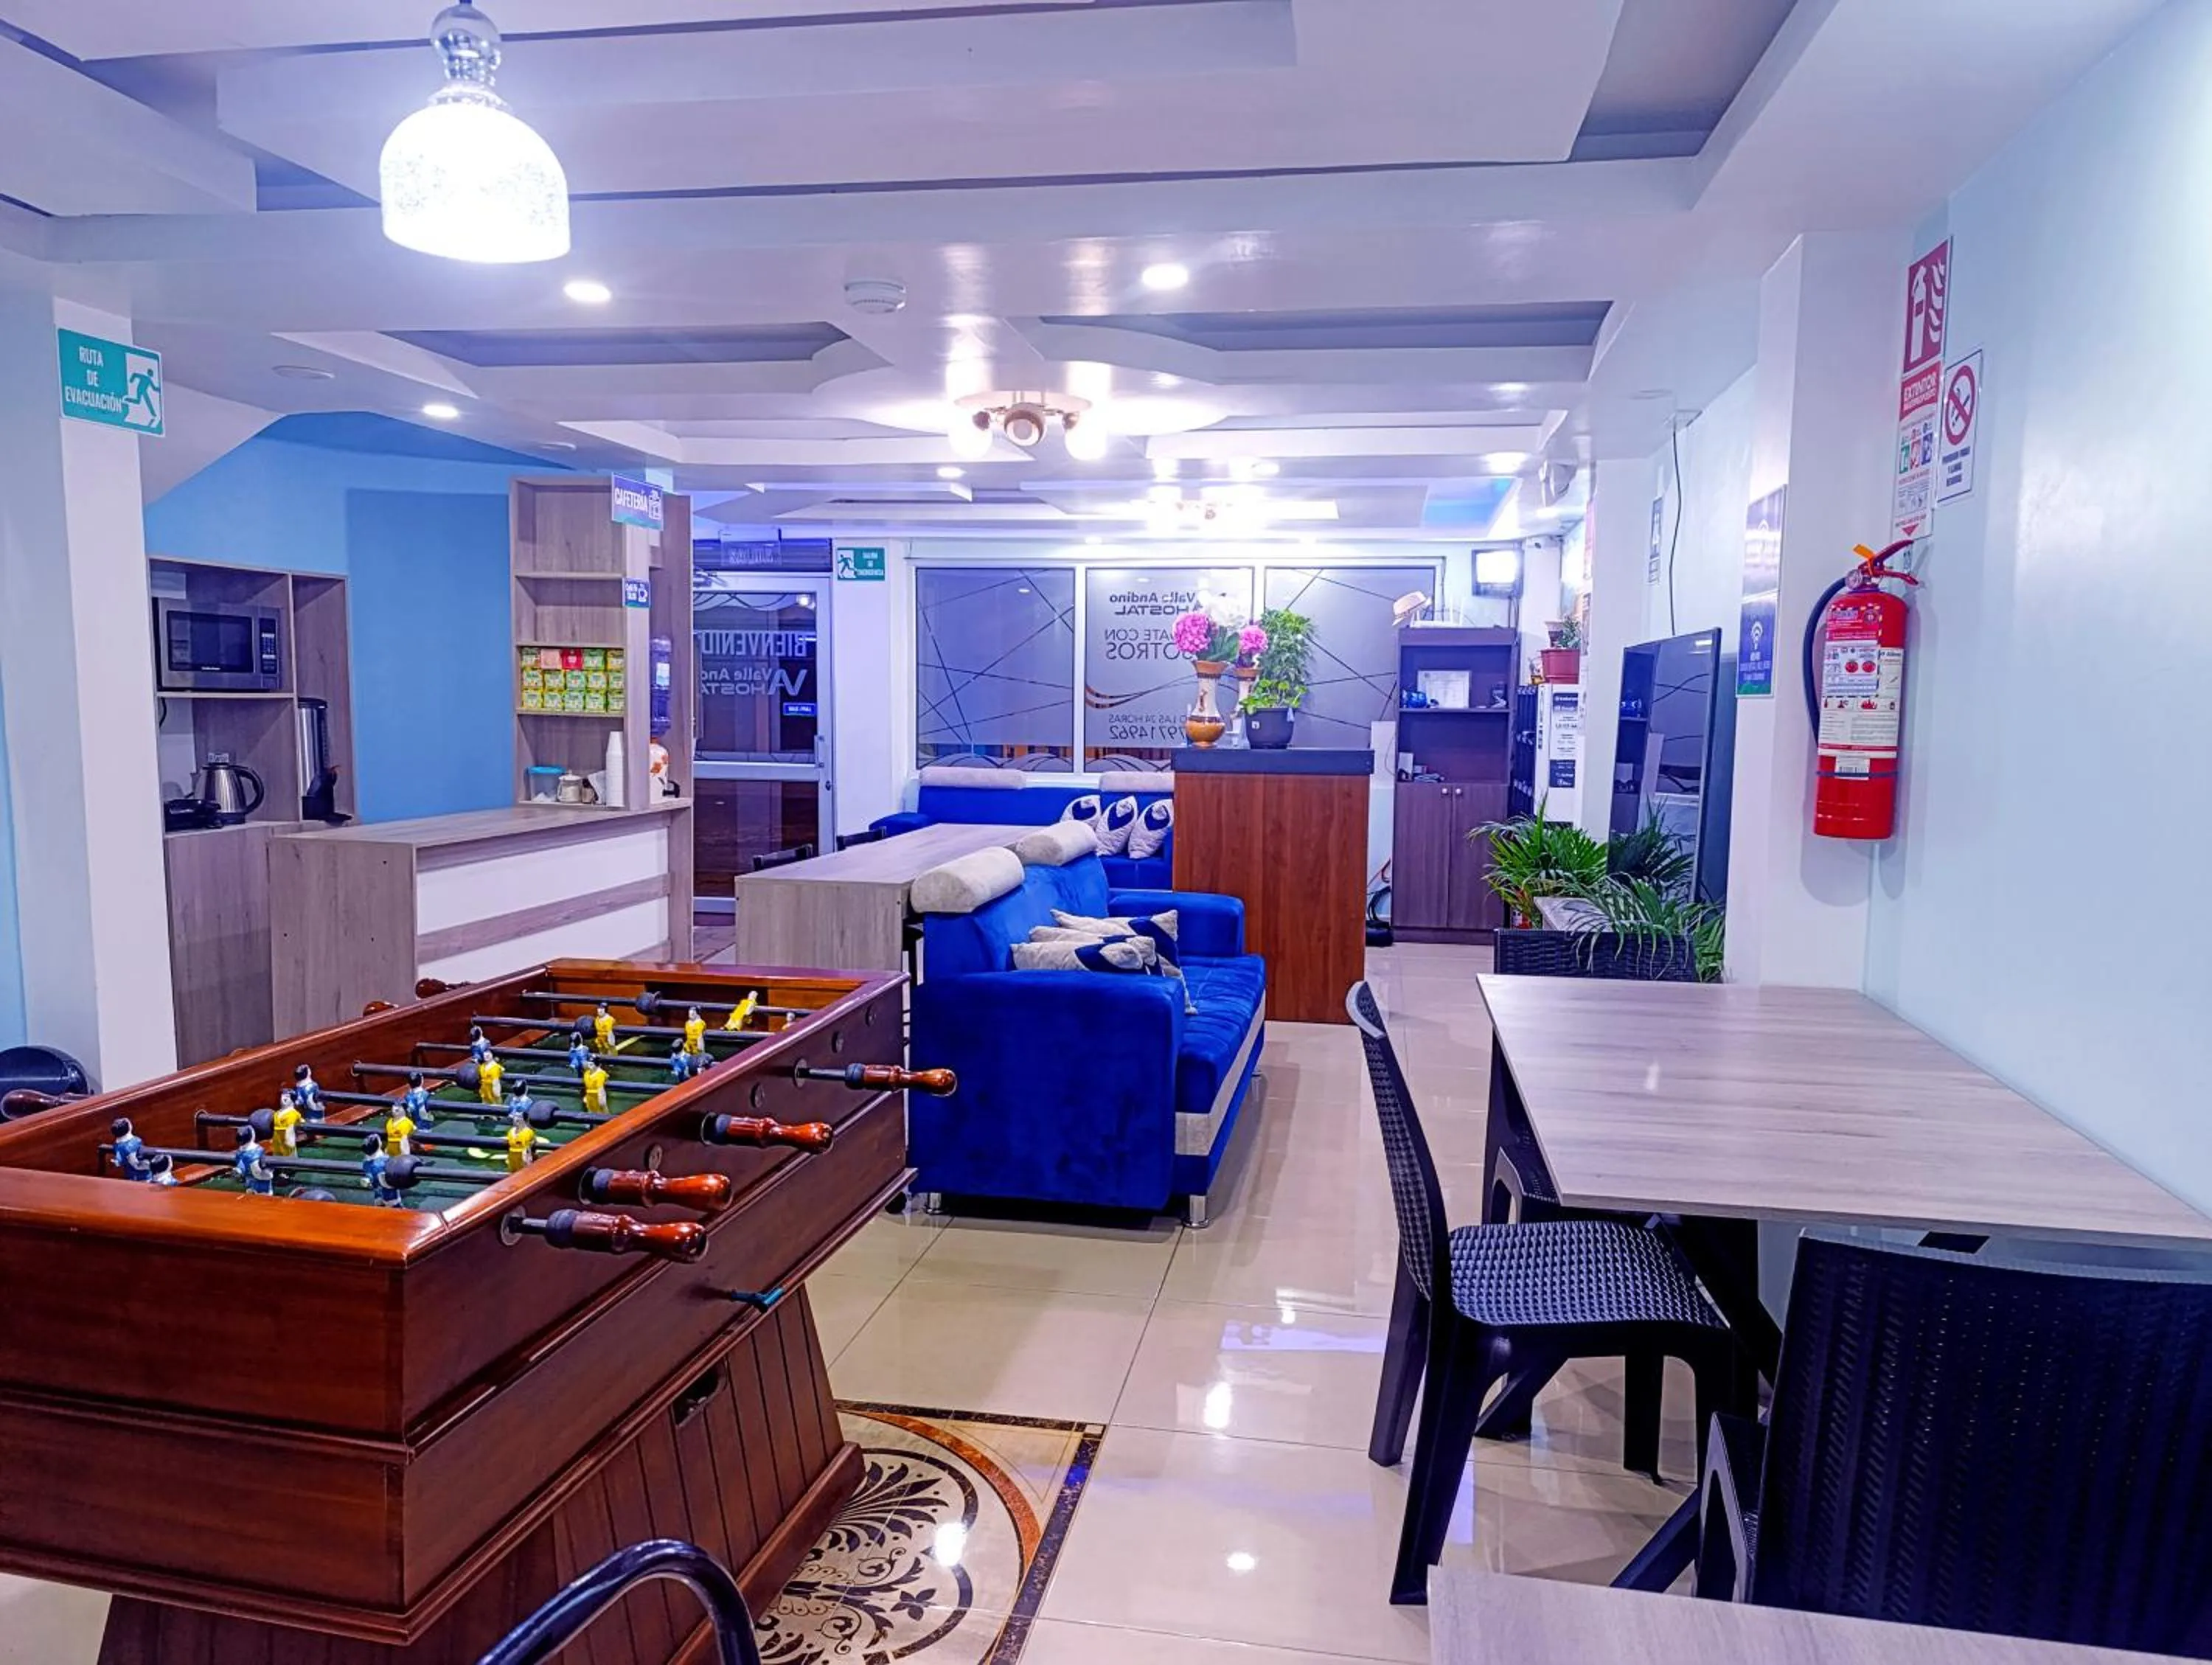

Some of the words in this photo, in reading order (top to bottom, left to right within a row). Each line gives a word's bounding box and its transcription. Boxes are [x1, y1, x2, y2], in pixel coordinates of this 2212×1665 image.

[79, 347, 104, 366] RUTA
[86, 369, 100, 387] DE
[65, 386, 122, 413] EVACUACIÓN
[614, 487, 648, 512] CAFETERÍA
